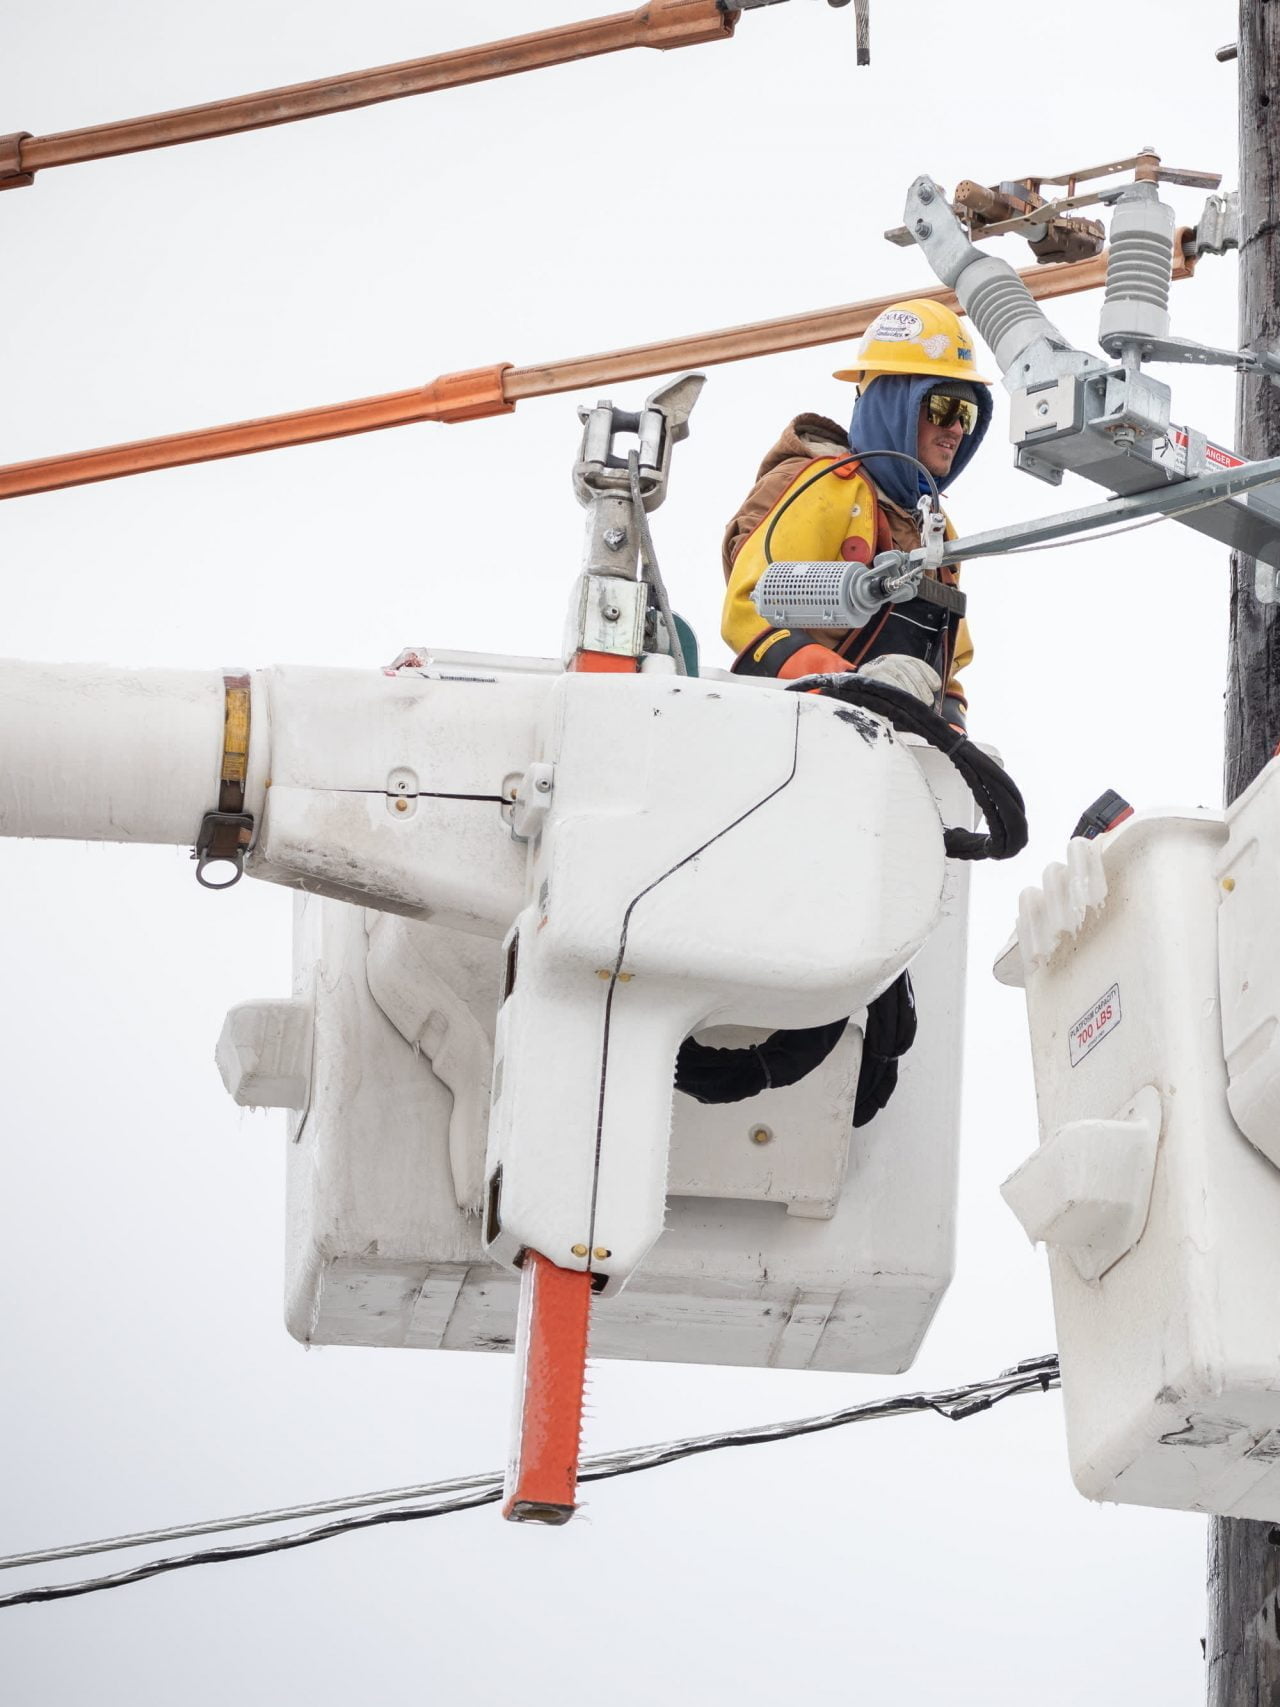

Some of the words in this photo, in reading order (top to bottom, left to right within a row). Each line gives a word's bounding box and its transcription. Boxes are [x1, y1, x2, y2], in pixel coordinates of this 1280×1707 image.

[1205, 447, 1231, 468] ANGER
[1070, 1011, 1094, 1039] PLATFORM
[1095, 990, 1116, 1014] CAPACITY
[1077, 1024, 1093, 1048] 700
[1096, 1005, 1112, 1030] LBS
